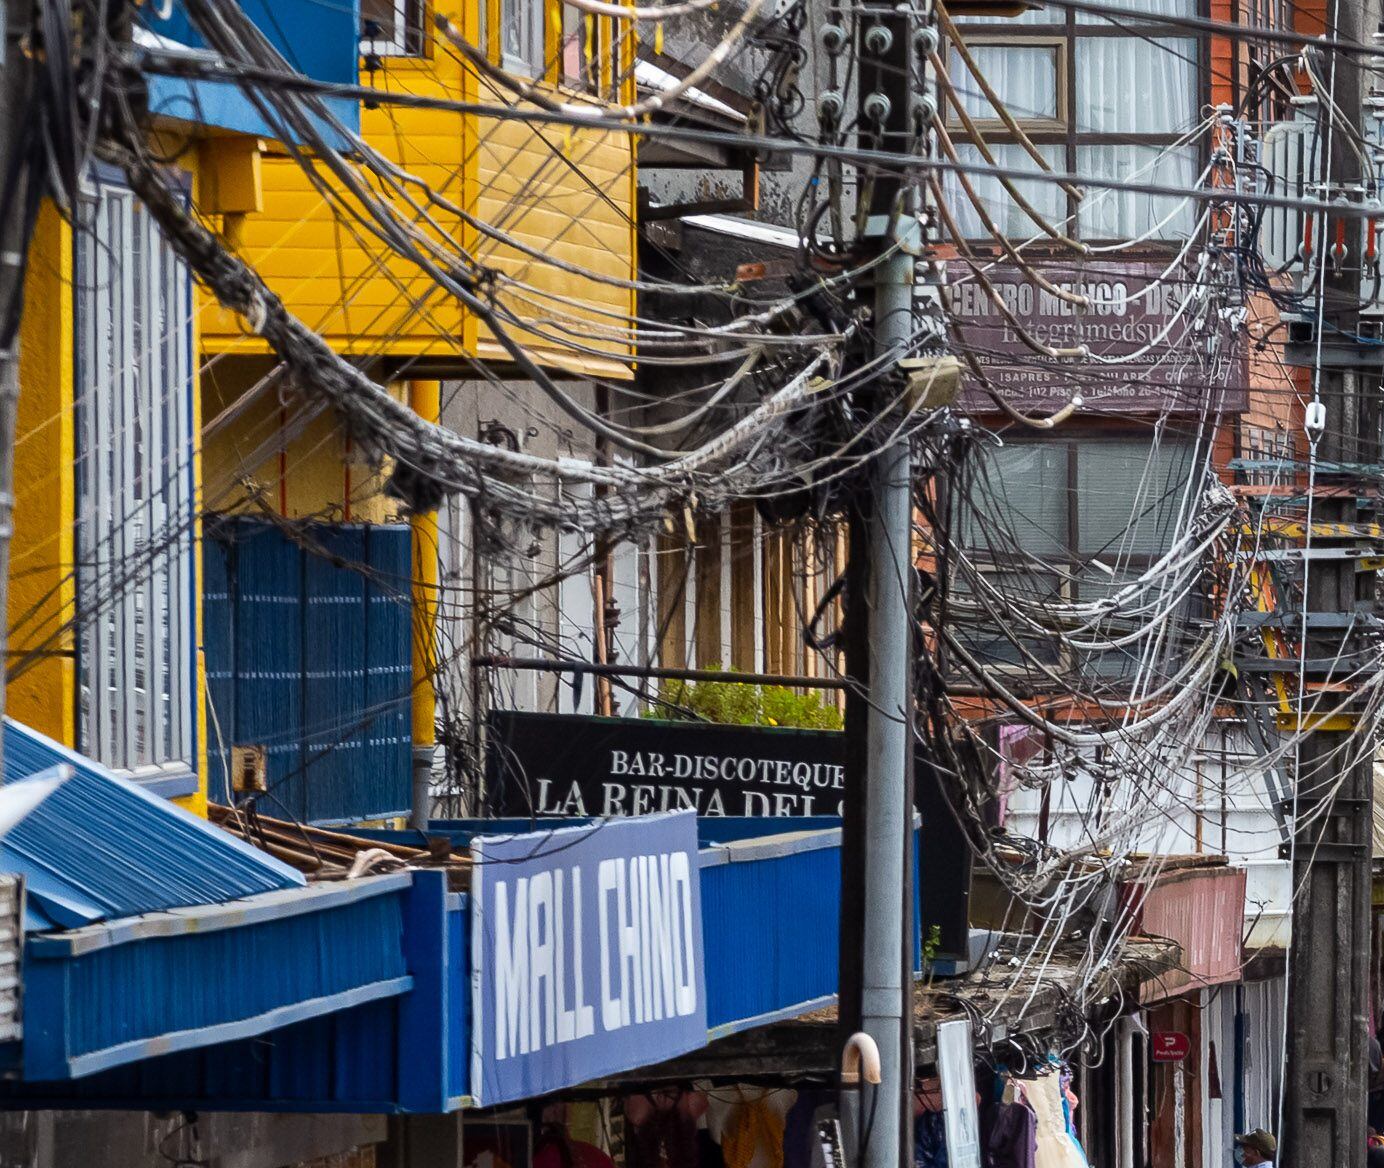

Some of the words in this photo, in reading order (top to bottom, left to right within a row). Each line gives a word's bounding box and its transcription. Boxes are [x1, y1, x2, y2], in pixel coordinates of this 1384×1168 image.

[535, 778, 589, 818] LA
[600, 782, 727, 818] REINA
[494, 864, 595, 1060] MALL
[598, 851, 697, 1032] CHINO
